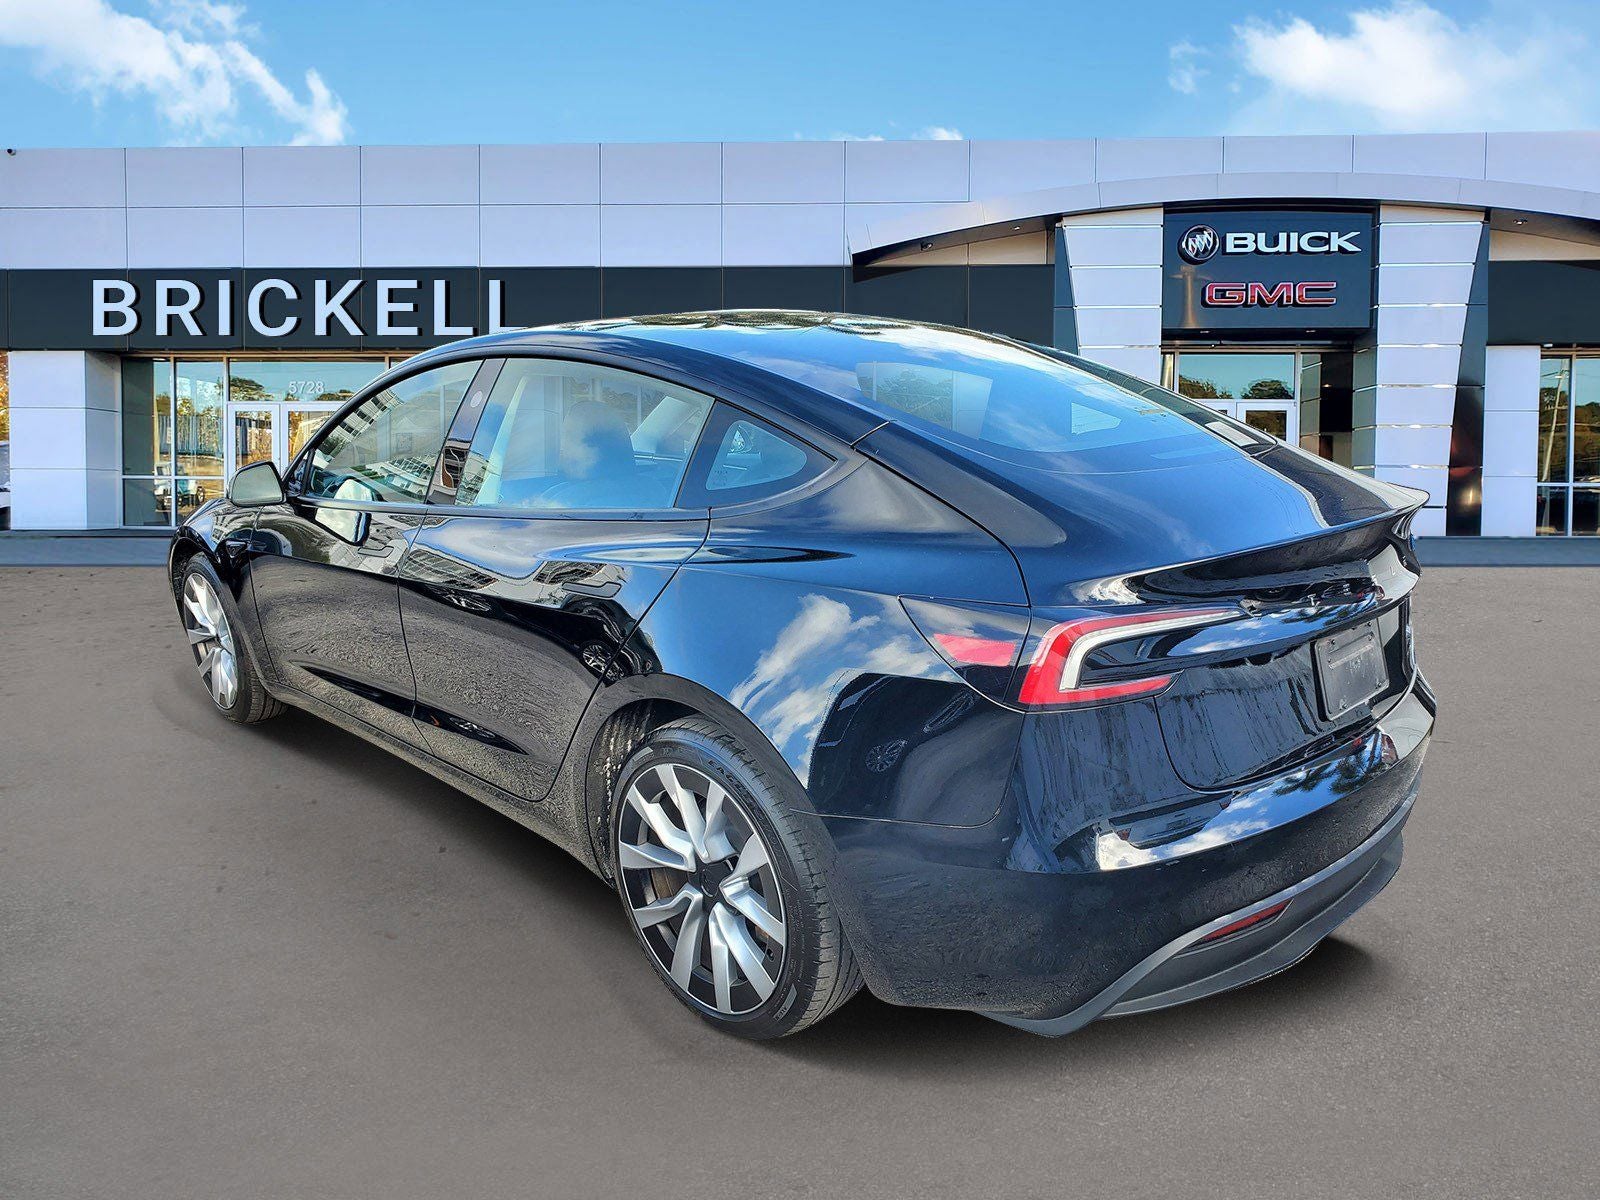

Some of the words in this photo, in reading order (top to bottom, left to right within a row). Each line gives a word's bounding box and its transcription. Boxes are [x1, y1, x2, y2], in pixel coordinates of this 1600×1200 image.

[1226, 231, 1361, 253] BUICK
[1205, 281, 1337, 305] GMC
[92, 279, 527, 336] BRICKELL
[289, 380, 325, 394] 5728
